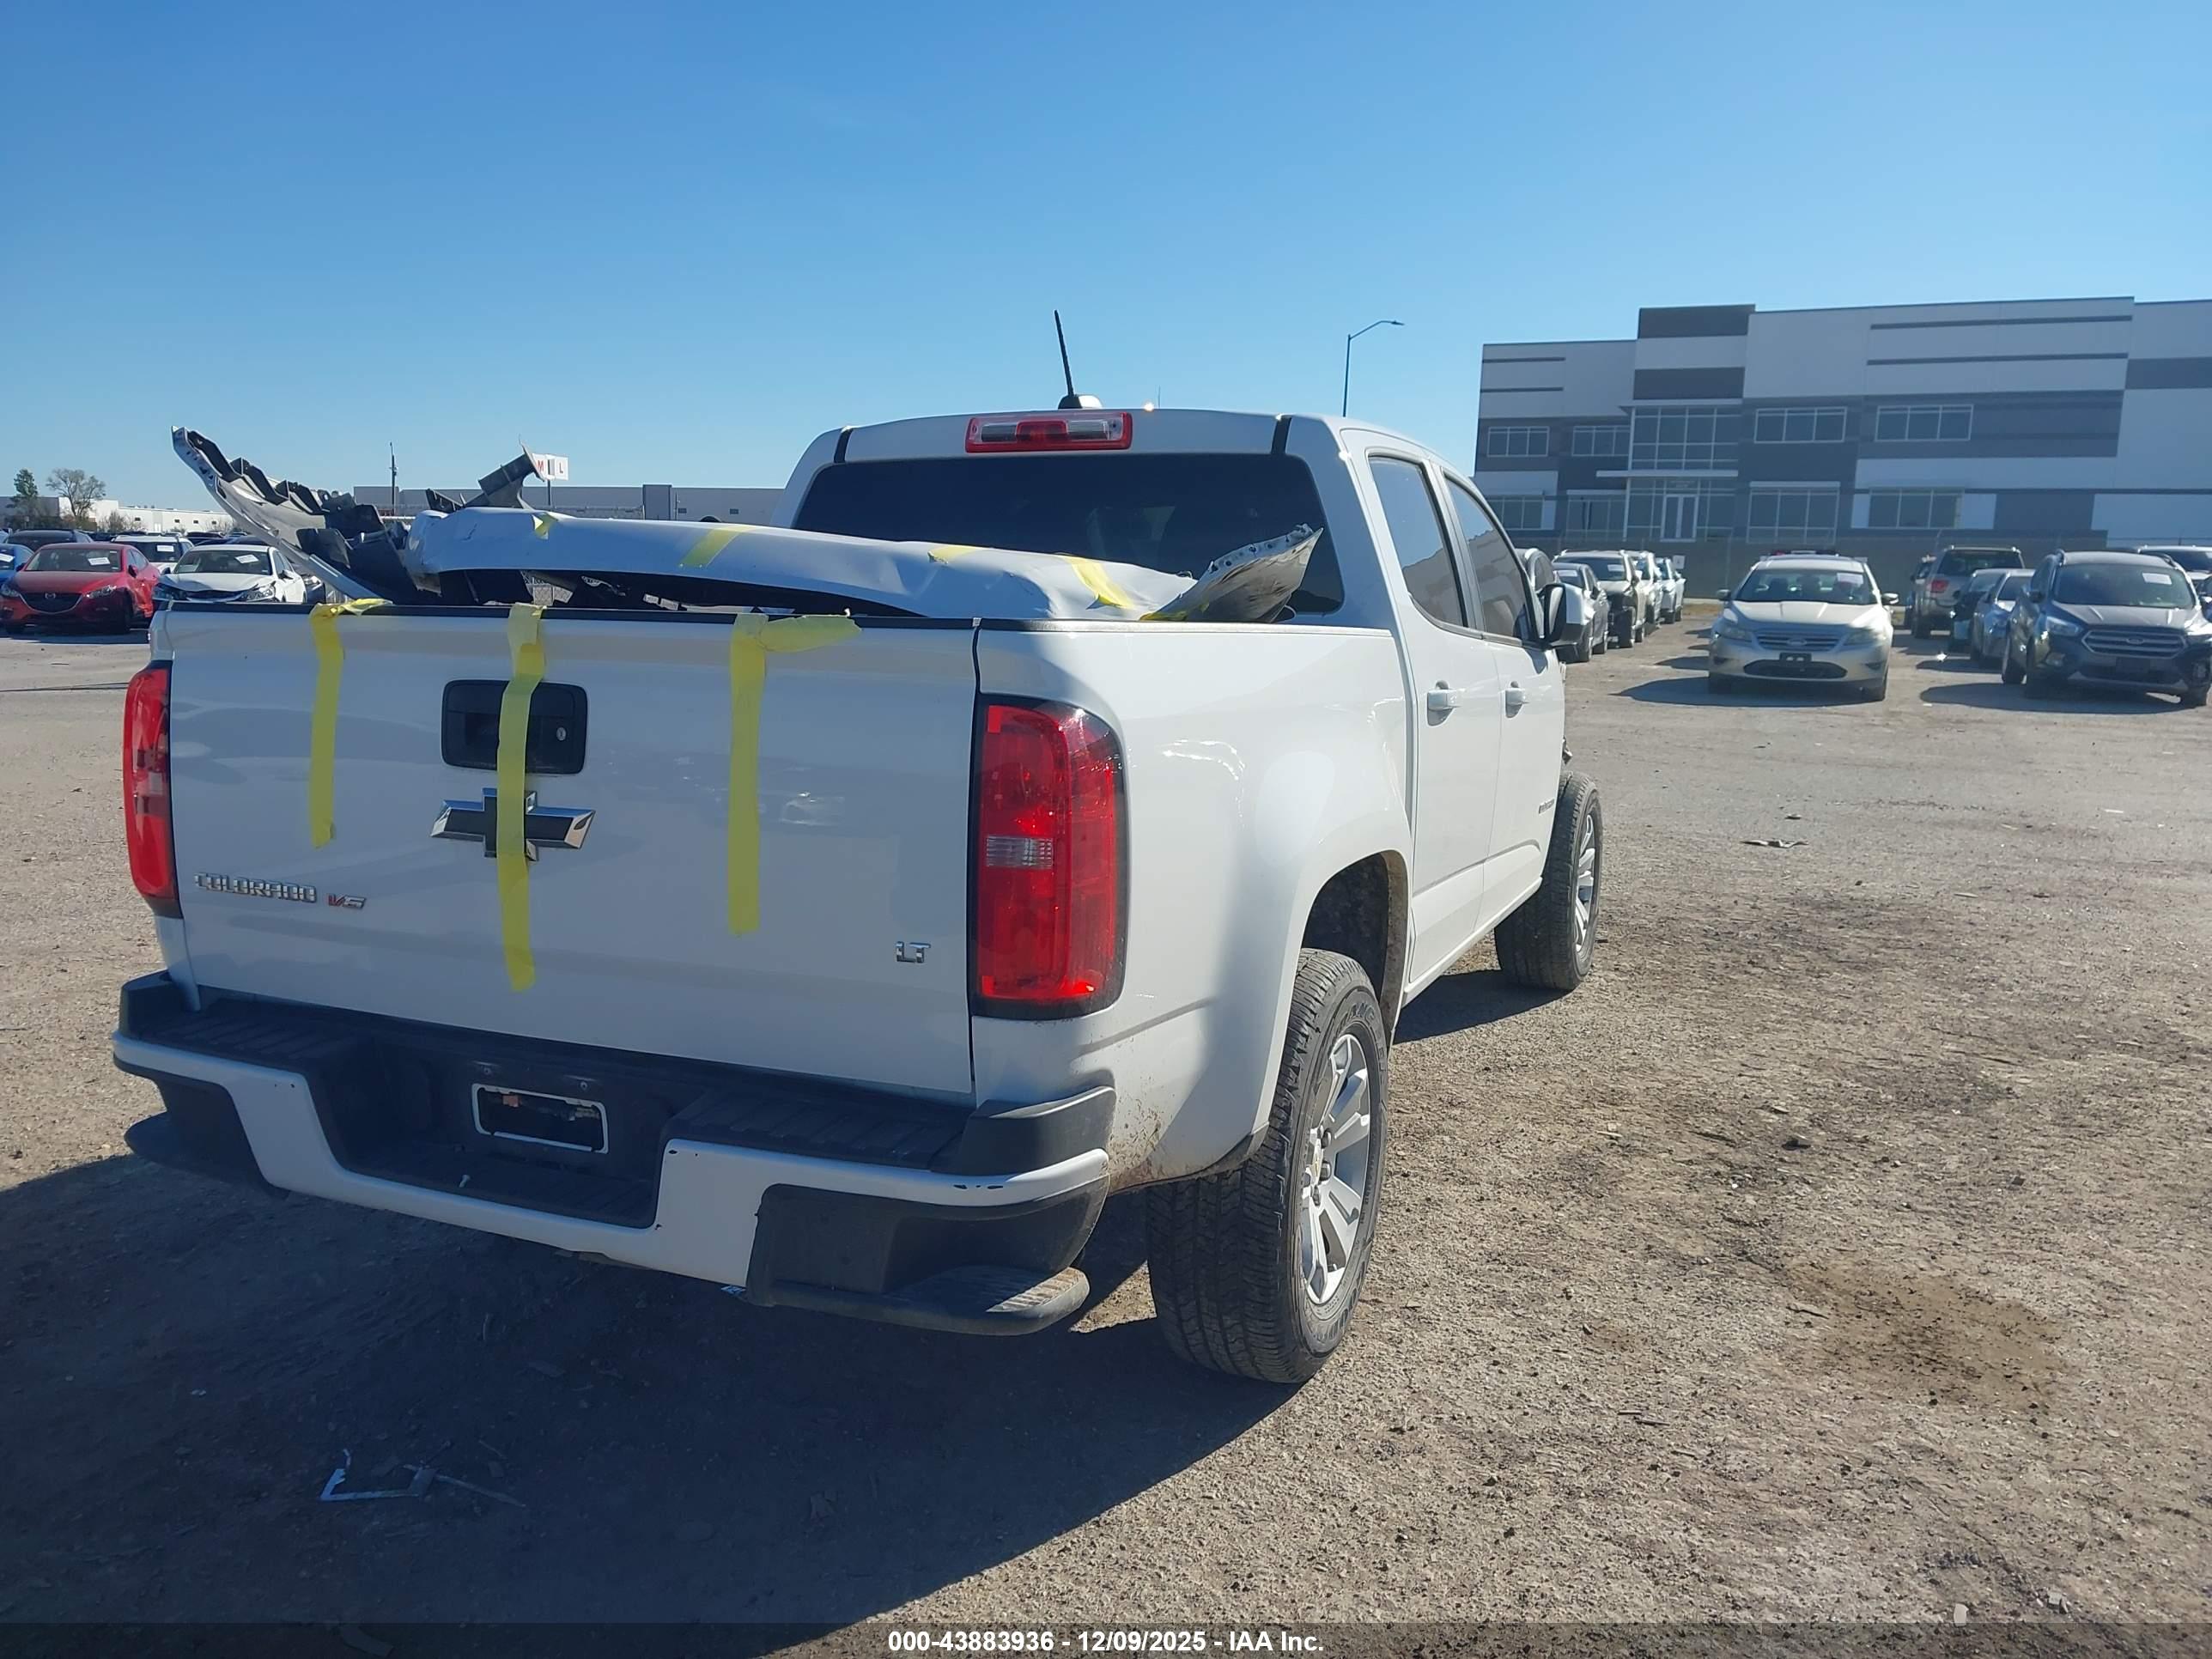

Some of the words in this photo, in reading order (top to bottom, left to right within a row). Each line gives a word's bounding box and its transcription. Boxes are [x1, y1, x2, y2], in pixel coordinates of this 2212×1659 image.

[194, 872, 318, 903] COLORADO
[327, 893, 367, 909] V6
[895, 941, 932, 963] LT
